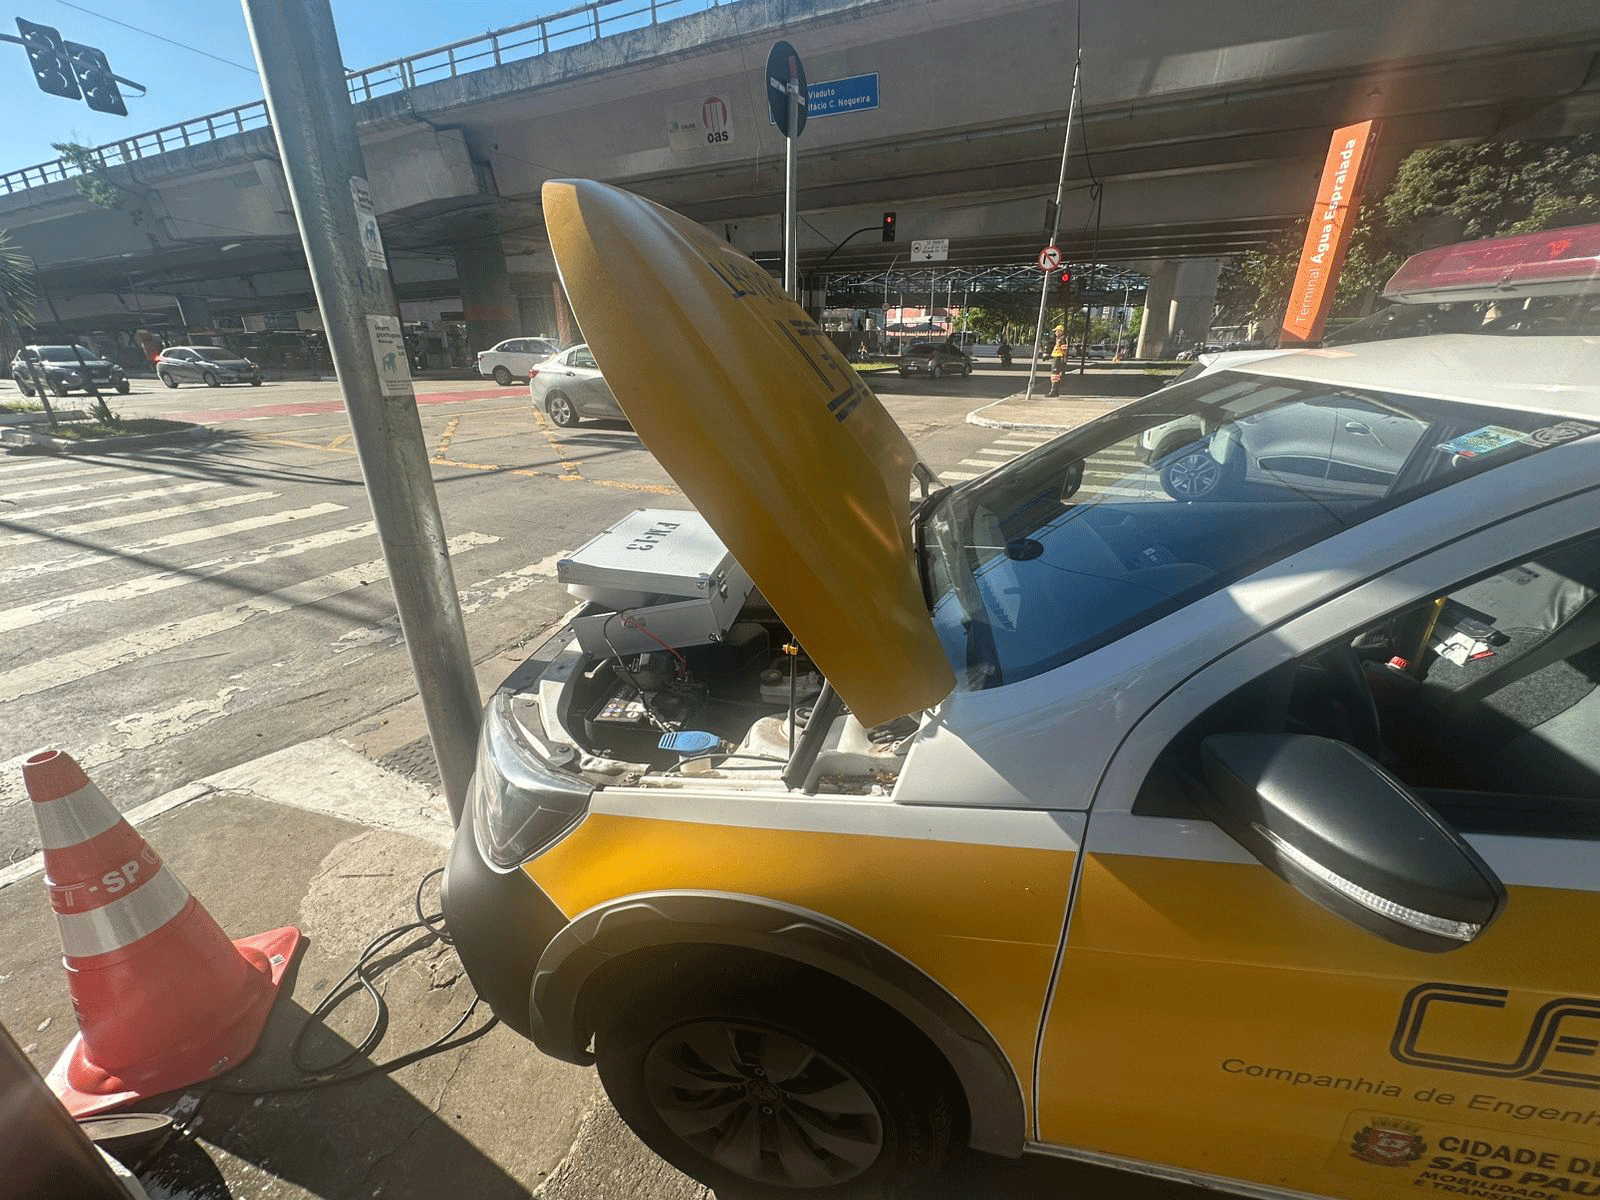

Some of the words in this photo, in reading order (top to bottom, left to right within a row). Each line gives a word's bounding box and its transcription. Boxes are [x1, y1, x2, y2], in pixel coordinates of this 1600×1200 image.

[838, 95, 870, 108] Nogueira
[707, 131, 729, 144] oas
[1296, 268, 1320, 324] Terminal
[1310, 223, 1332, 264] Água
[1323, 138, 1357, 222] Espraiada
[102, 860, 140, 893] SP
[1221, 1057, 1403, 1098] Companhia
[1414, 1087, 1456, 1106] de
[1427, 1156, 1512, 1180] SÃO
[1438, 1136, 1560, 1170] CIDADE
[1419, 1171, 1561, 1200] MOBILIDADE
